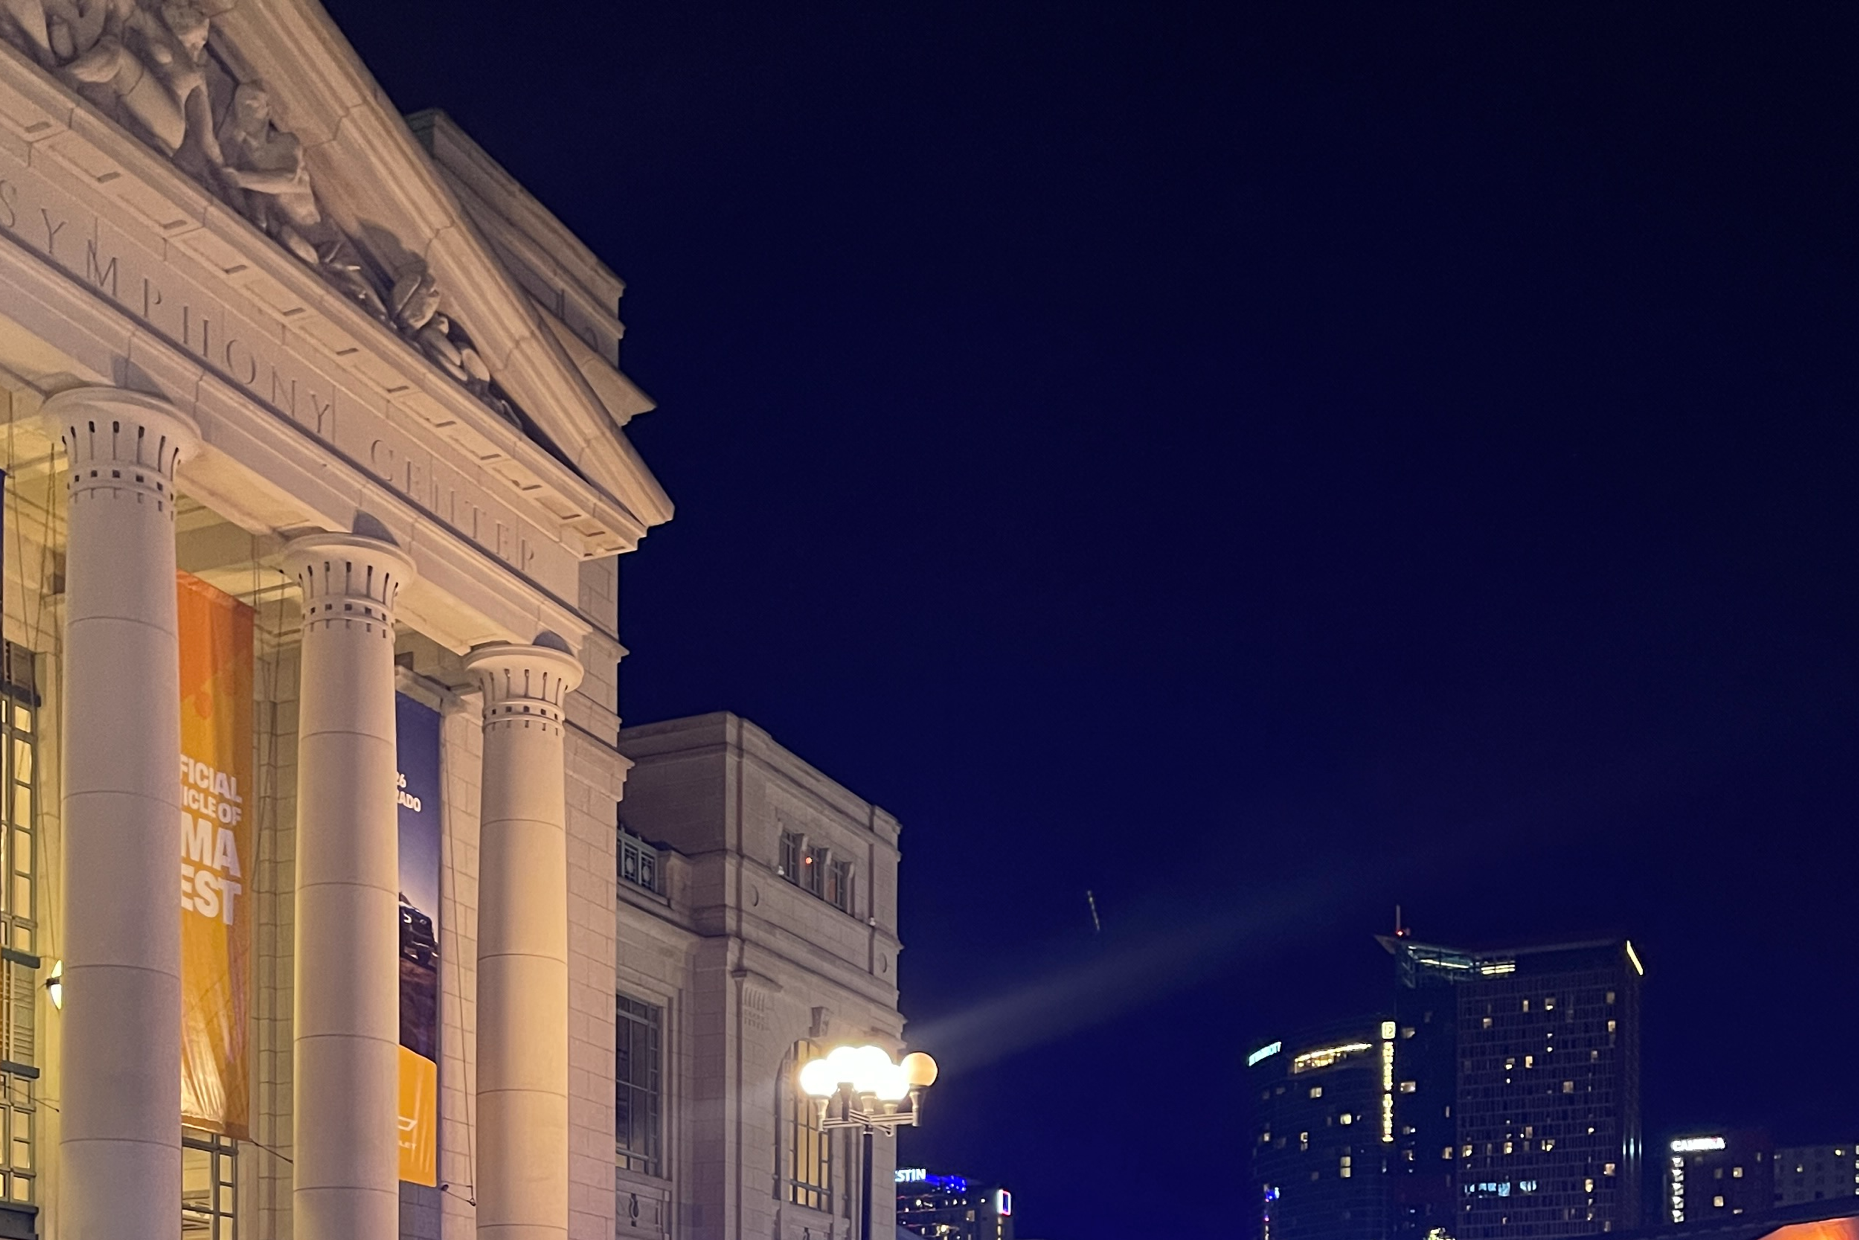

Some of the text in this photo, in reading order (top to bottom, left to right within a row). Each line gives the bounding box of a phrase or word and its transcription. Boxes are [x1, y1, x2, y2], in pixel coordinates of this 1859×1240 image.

[0, 179, 535, 571] SYMPHONY CENTER
[181, 811, 241, 878] MA
[217, 803, 242, 826] OF
[181, 863, 242, 926] EST
[895, 1168, 926, 1183] STIN
